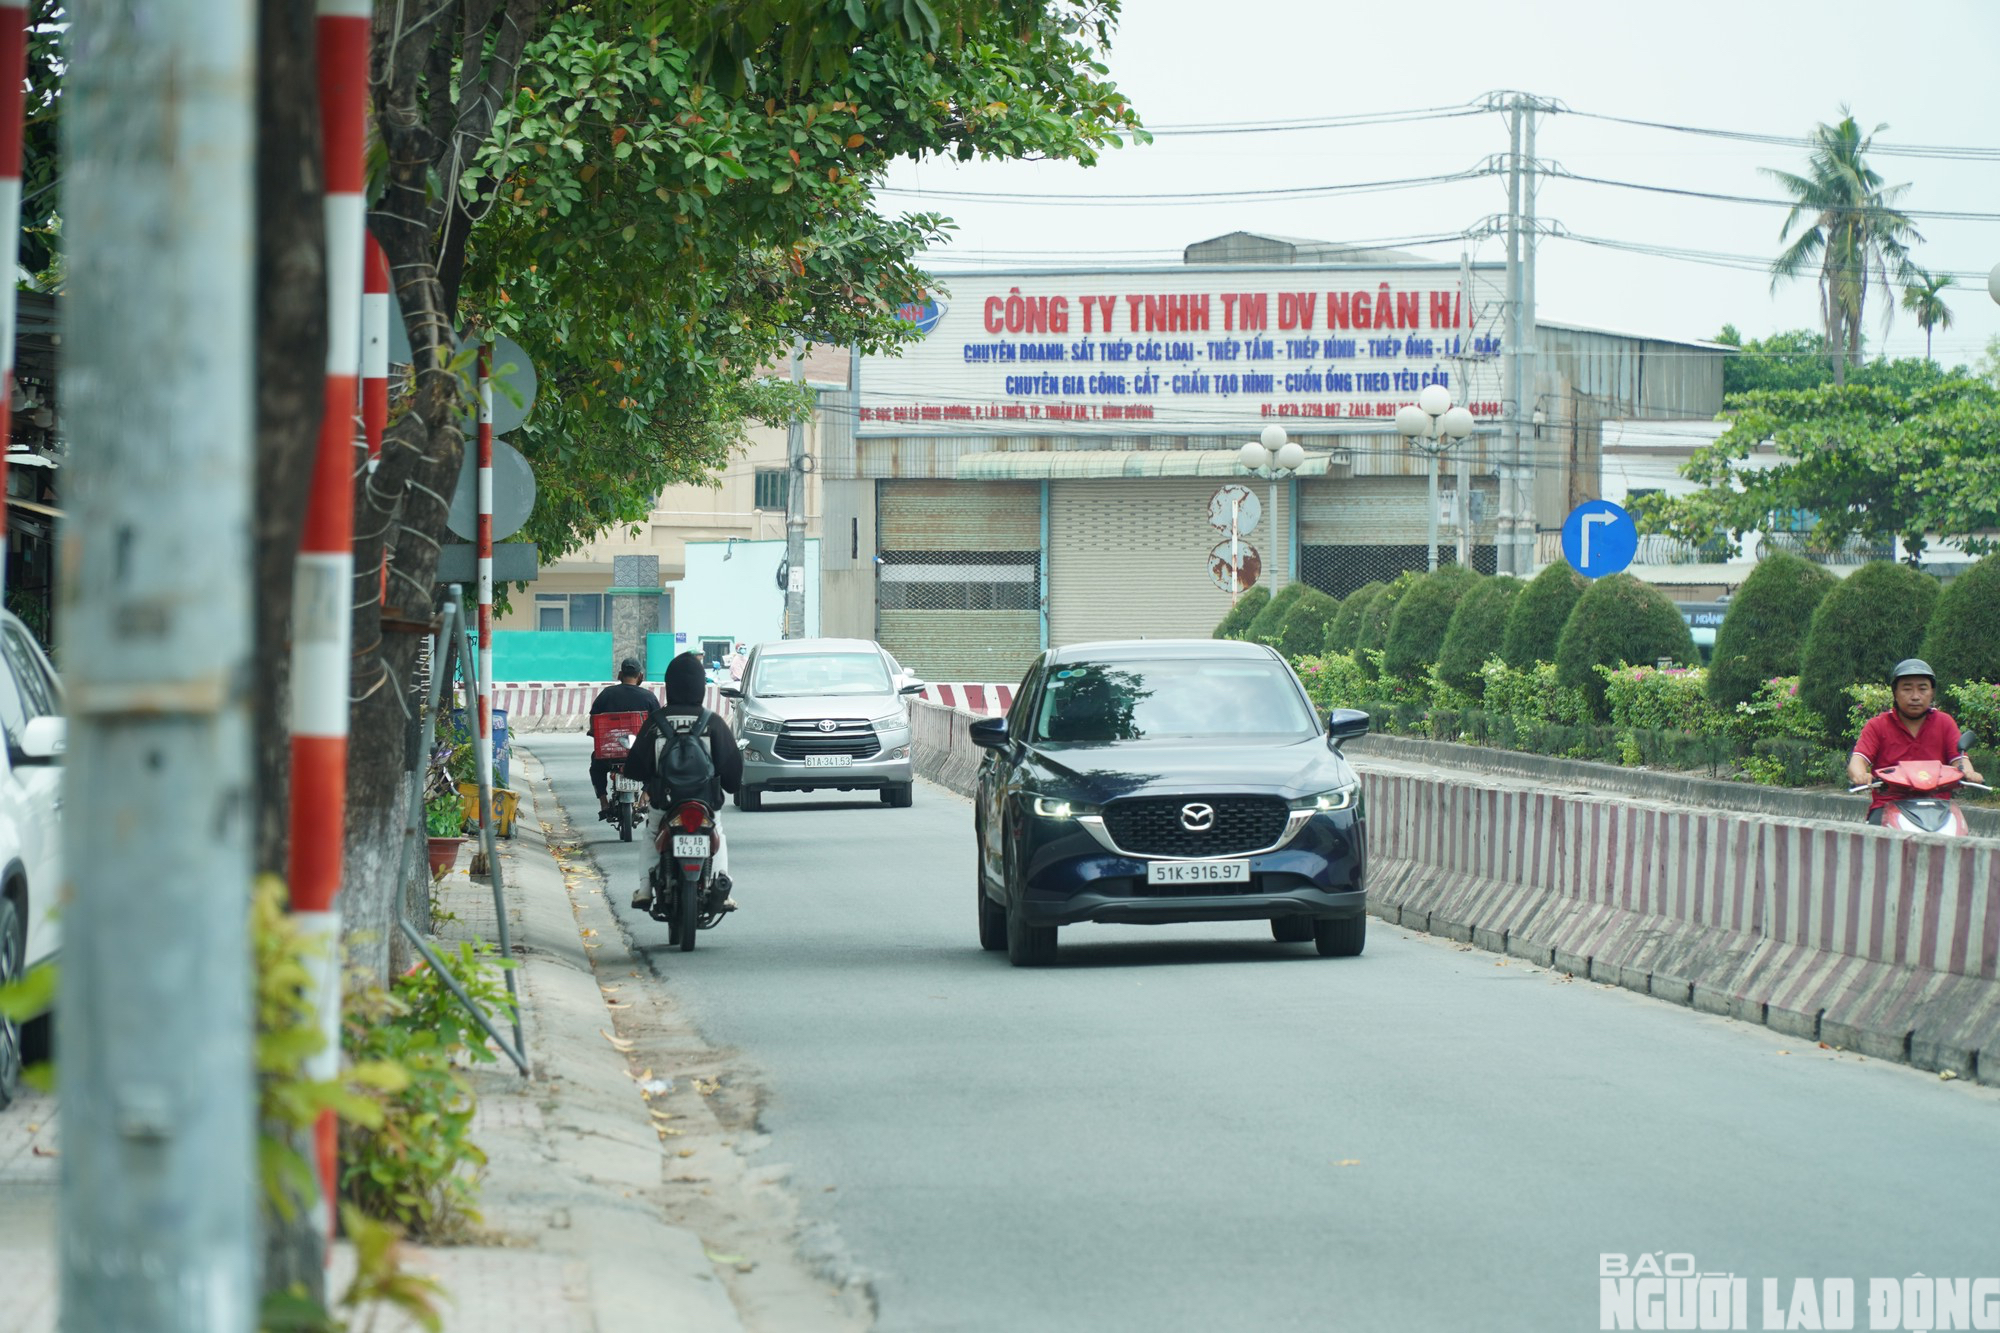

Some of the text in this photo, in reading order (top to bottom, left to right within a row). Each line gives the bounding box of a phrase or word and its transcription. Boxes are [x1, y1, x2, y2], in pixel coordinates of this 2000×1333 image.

[984, 287, 1068, 334] CÔNG
[1078, 295, 1117, 334] TY
[1125, 293, 1210, 333] TNHH
[1221, 293, 1267, 331] TM
[1278, 292, 1317, 330] DV
[1327, 282, 1419, 330] NGÂN
[963, 340, 1016, 363] CHUYÊN
[1020, 342, 1068, 363] DOANH:
[1071, 336, 1095, 361] SẮT
[1100, 338, 1133, 361] THÉP
[1136, 338, 1162, 361] CÁC
[1165, 341, 1194, 368] LOẠI
[1206, 337, 1241, 361] THÉP
[1244, 332, 1274, 360] TẤM
[1285, 335, 1320, 360] THÉP
[1368, 334, 1402, 359] THÉP
[1006, 370, 1059, 395] CHUYÊN
[1062, 375, 1085, 395] GIA
[1089, 371, 1131, 395] CÔNG:
[1134, 366, 1160, 394] CẮT
[1213, 374, 1239, 398] TẠO
[1242, 369, 1273, 394] HÌNH
[1285, 365, 1322, 392] CUỐN
[1325, 365, 1353, 393] ỐNG
[1355, 372, 1390, 392] THEO
[1393, 367, 1419, 391] YÊU
[676, 847, 707, 857] 143.91
[1157, 865, 1241, 881] 51K-916.97
